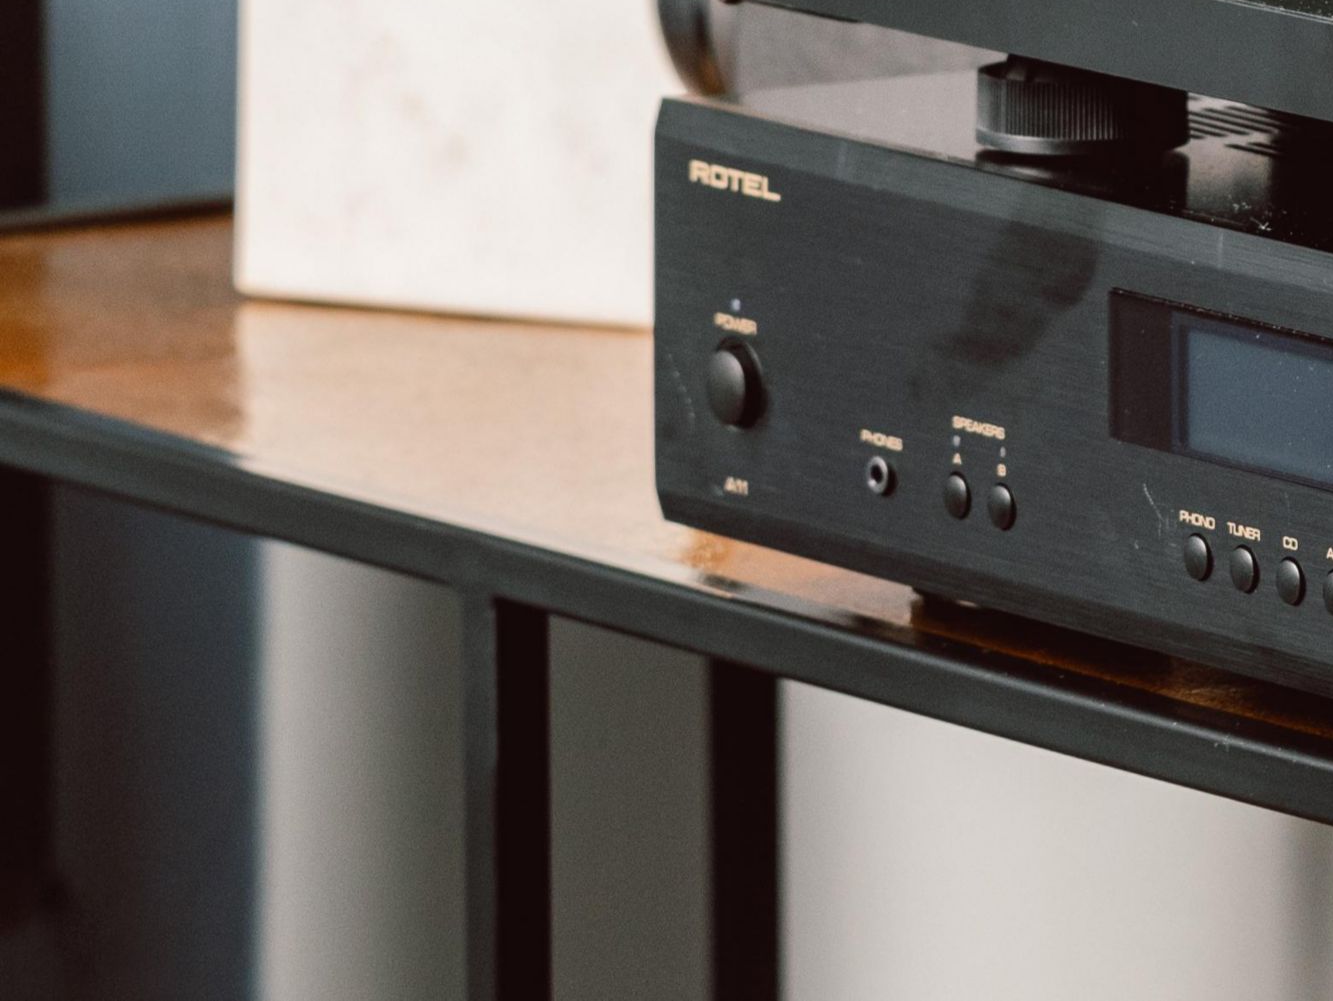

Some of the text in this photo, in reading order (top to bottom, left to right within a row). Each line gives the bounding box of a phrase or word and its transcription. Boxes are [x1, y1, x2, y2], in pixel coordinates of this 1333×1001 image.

[689, 159, 781, 202] ROTEL
[713, 311, 757, 336] POWER
[952, 415, 1006, 440] SPEAKERS
[859, 428, 903, 451] PHONES
[952, 452, 962, 465] A
[997, 463, 1007, 477] B
[1179, 509, 1216, 530] PHONO
[1226, 521, 1261, 542] TUNER
[1282, 535, 1299, 551] CD
